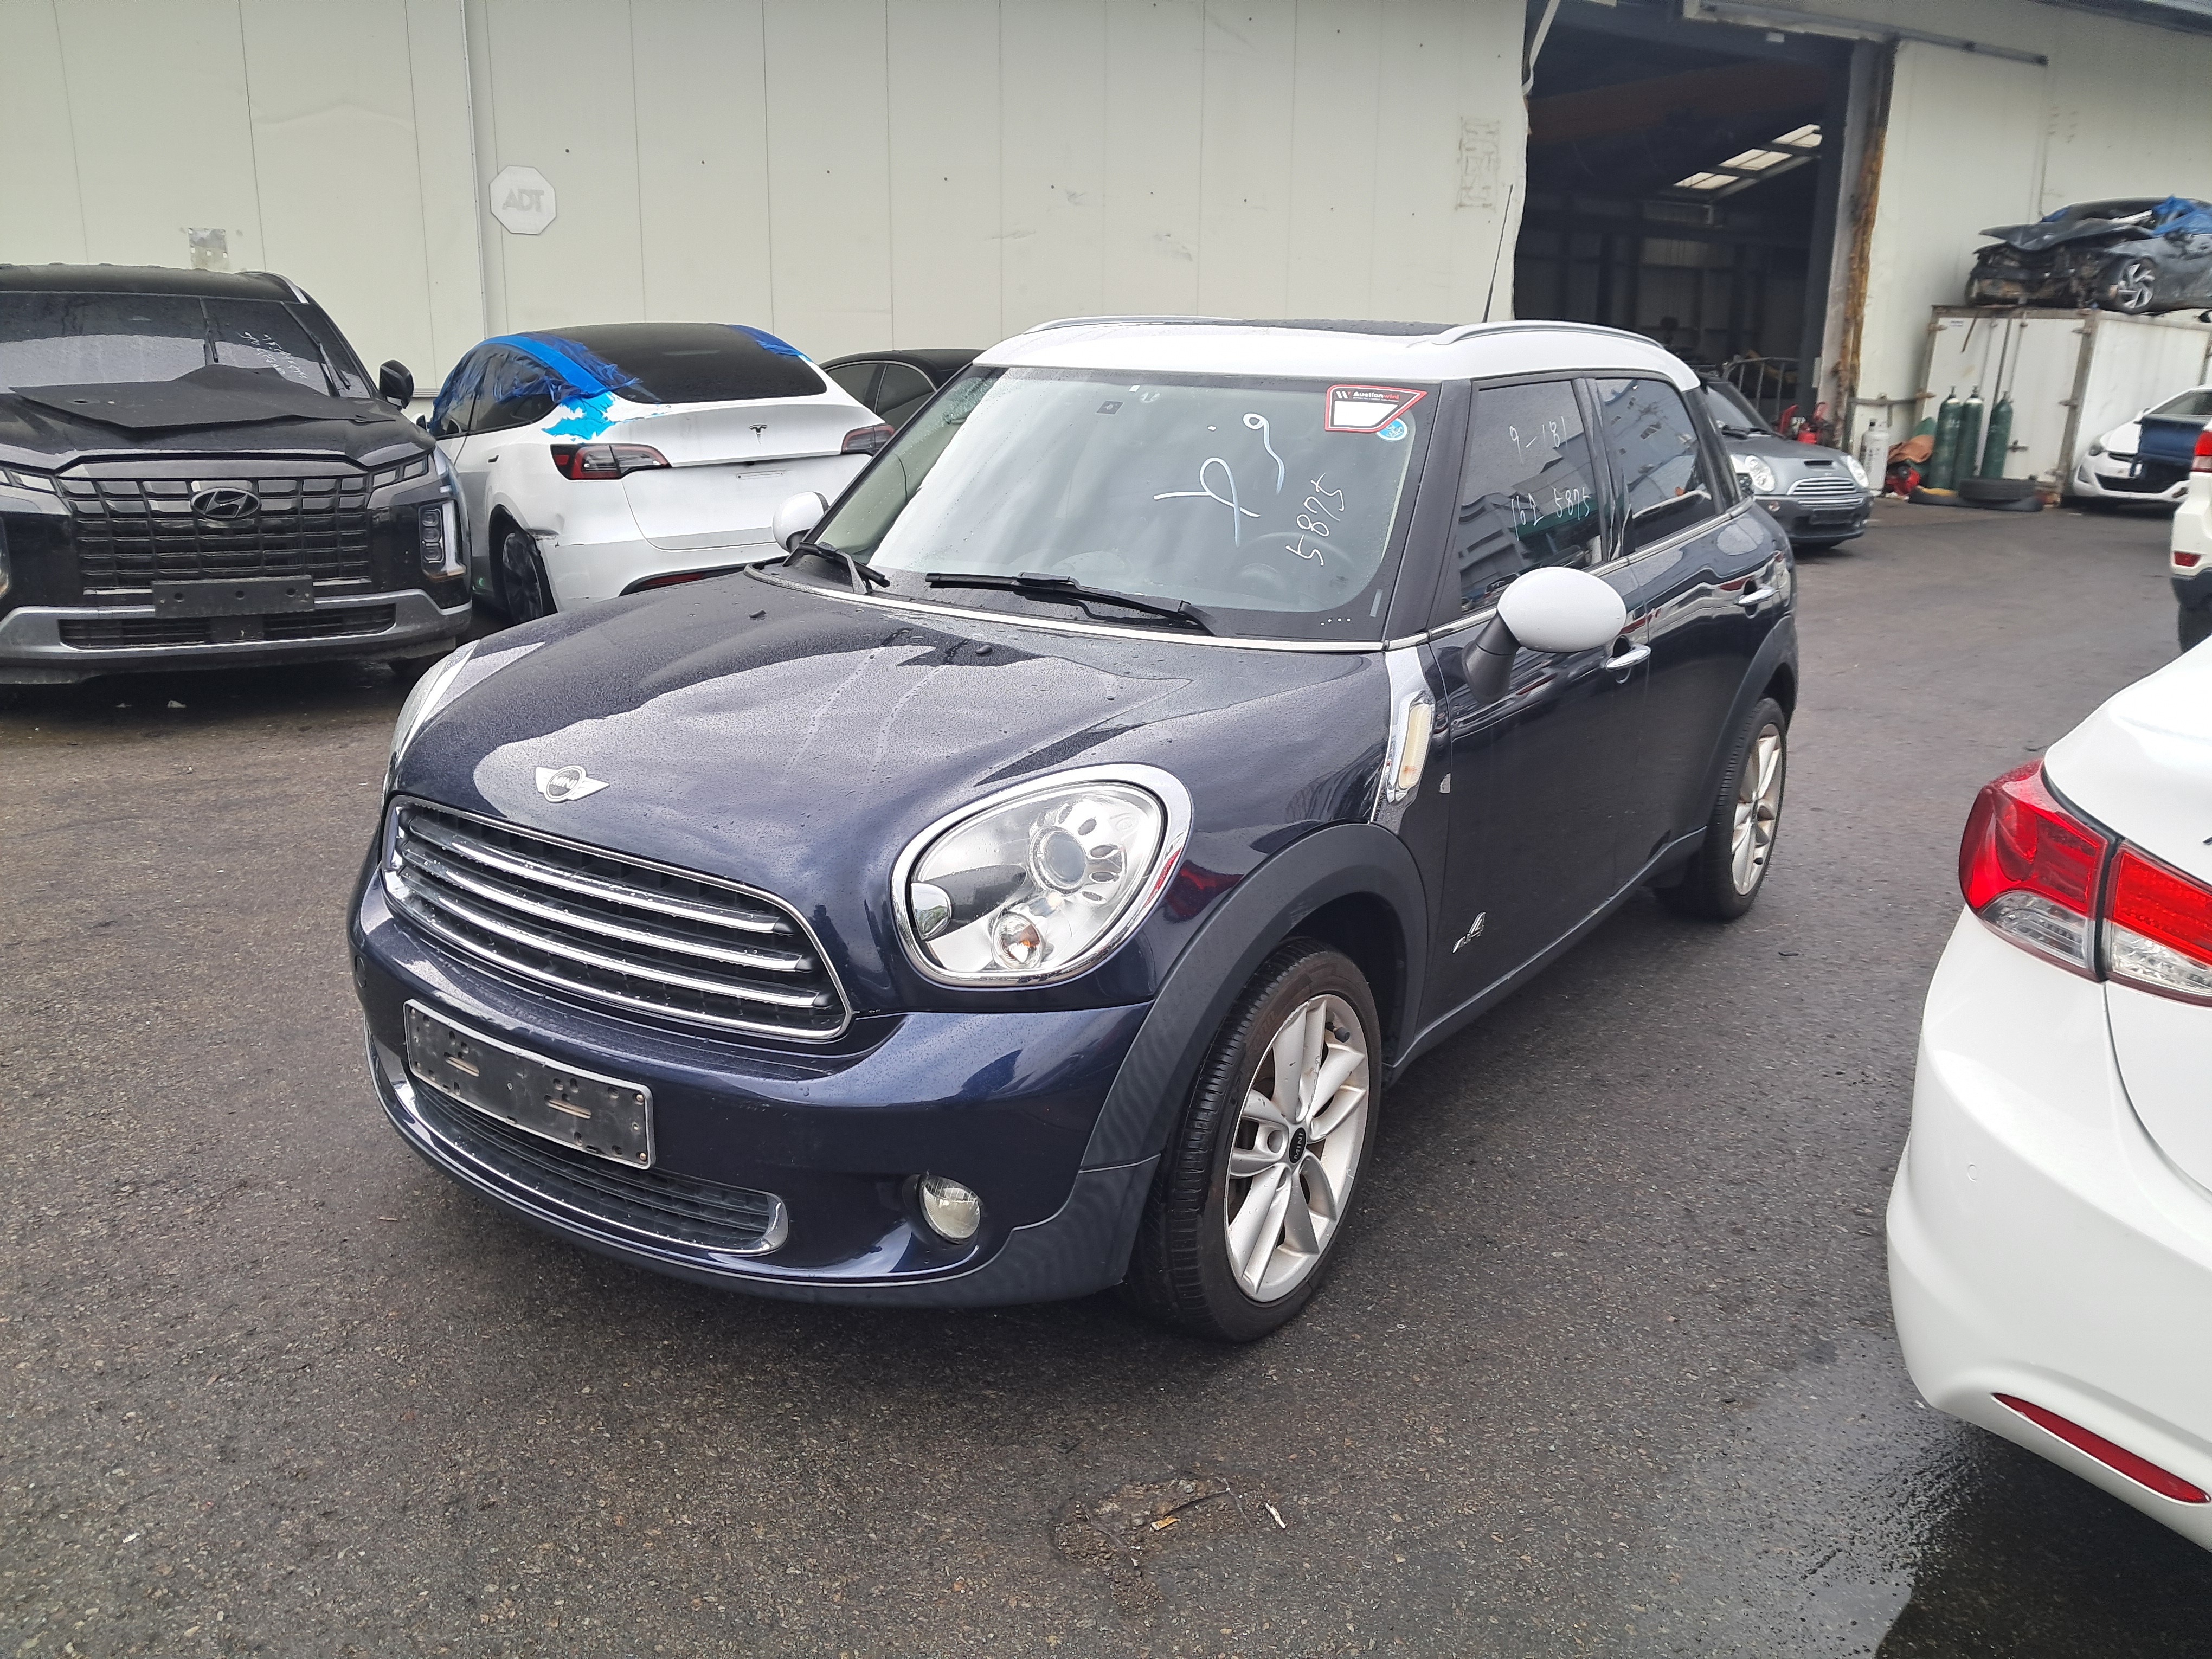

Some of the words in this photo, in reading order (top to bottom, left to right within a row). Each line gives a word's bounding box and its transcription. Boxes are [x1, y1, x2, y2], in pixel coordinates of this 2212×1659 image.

[502, 188, 544, 213] ADT
[1554, 487, 1591, 521] 5875
[1285, 473, 1345, 565] 5875
[549, 775, 578, 790] MINI
[1293, 1133, 1303, 1159] MINI
